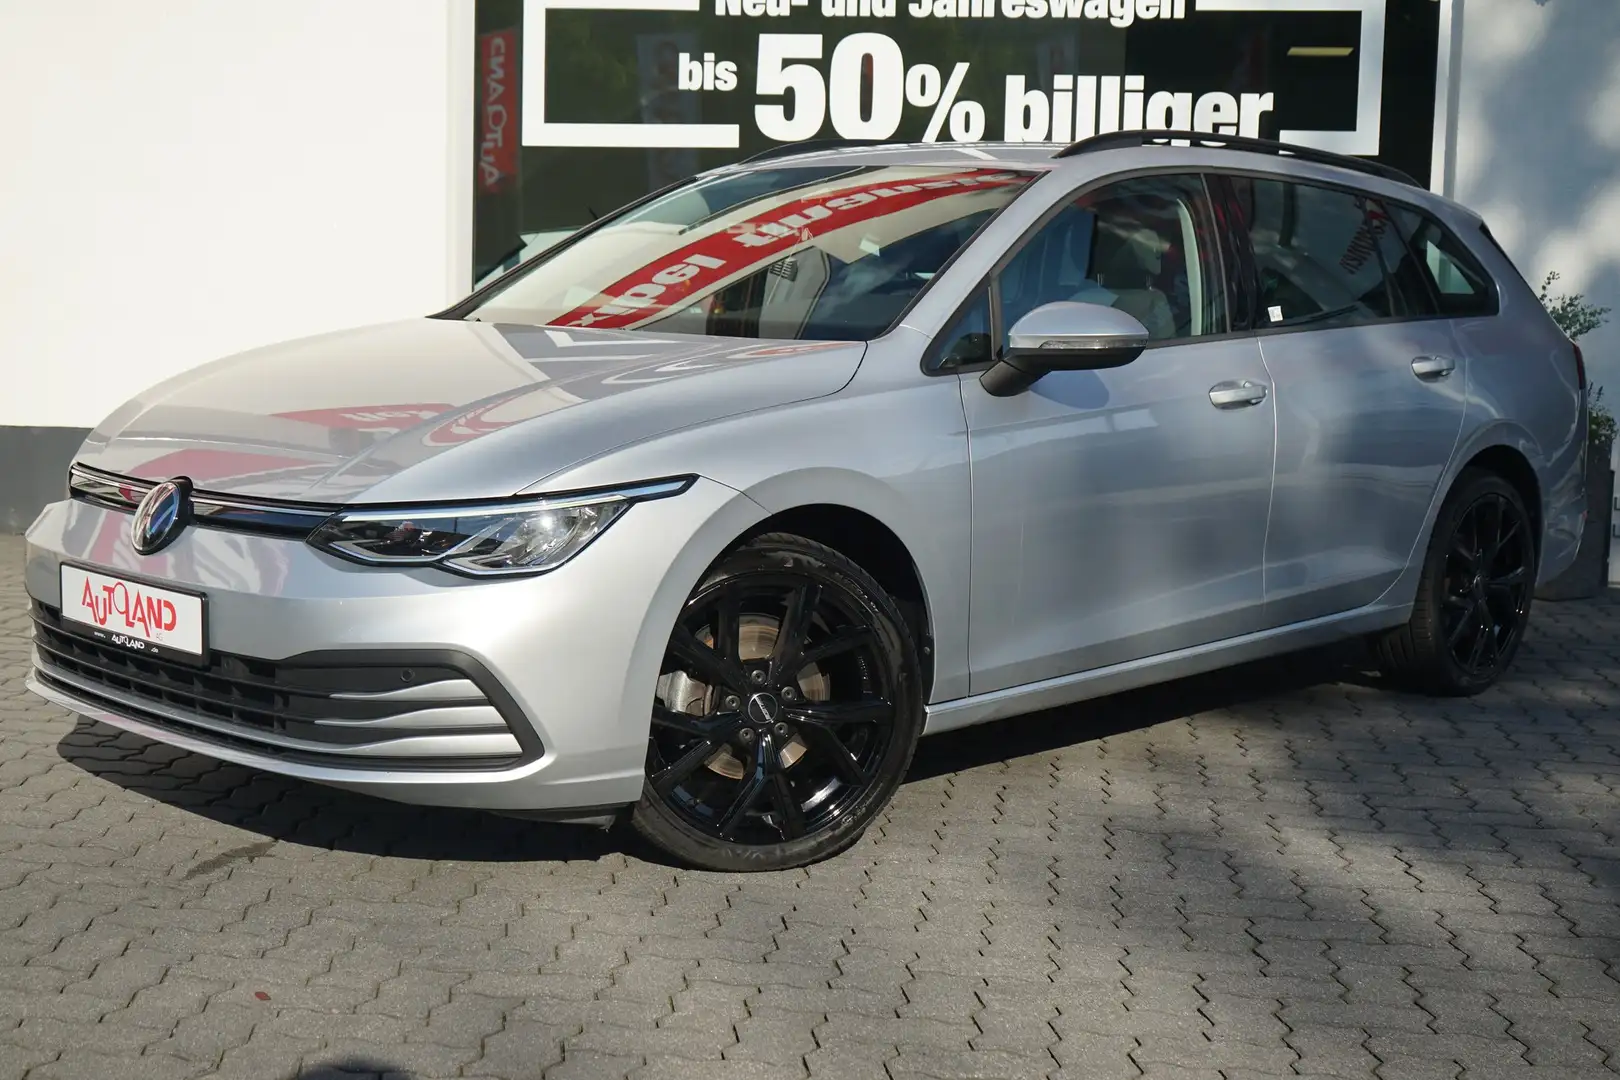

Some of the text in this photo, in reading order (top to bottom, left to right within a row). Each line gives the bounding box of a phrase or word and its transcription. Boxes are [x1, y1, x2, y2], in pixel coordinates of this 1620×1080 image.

[678, 53, 738, 91] bis
[754, 32, 985, 142] 50%
[82, 577, 176, 637] AUTOLAND
